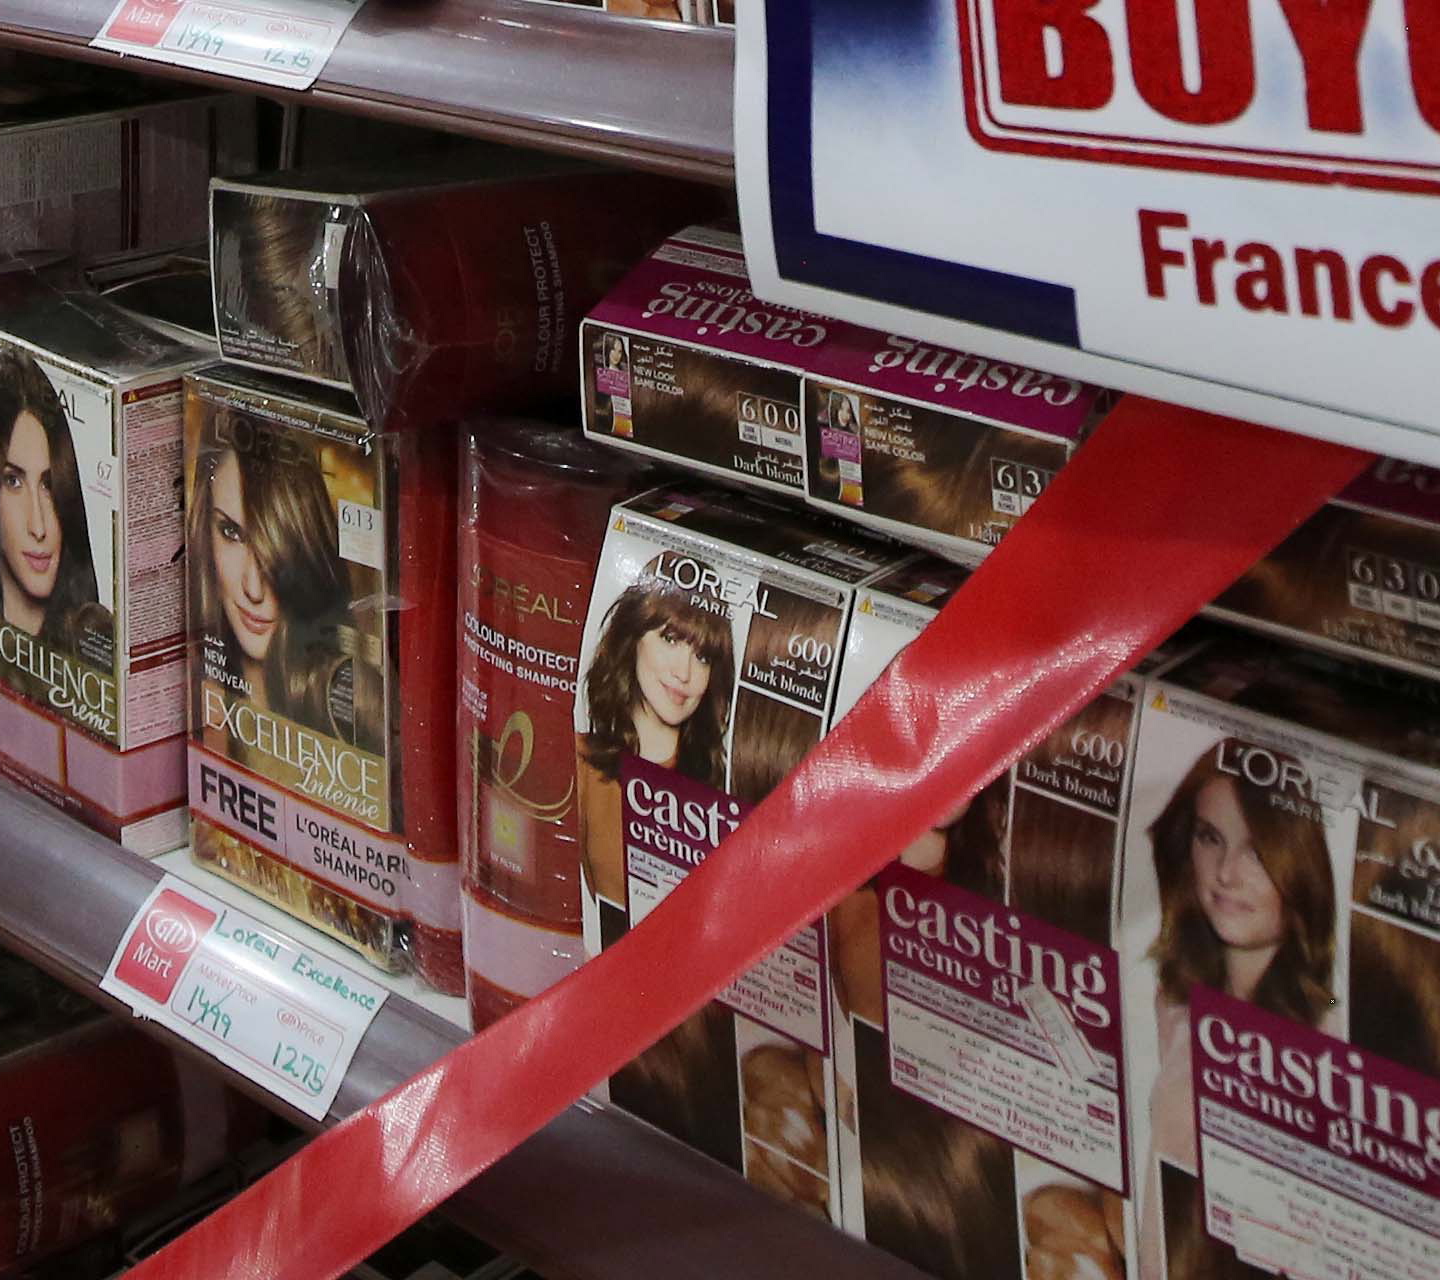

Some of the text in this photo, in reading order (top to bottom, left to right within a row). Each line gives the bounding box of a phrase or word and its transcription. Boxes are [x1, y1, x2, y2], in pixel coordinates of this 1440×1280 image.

[126, 5, 166, 26] Mart
[642, 282, 827, 348] casting
[633, 365, 676, 383] NEW LOOK
[633, 377, 684, 396] SAME COLOR
[733, 455, 764, 475] Dark
[892, 447, 926, 463] COLOR
[341, 502, 375, 531] 6.13
[654, 553, 778, 620] L'ORÉAL
[689, 593, 735, 620] PARIS
[203, 647, 227, 668] NEW
[507, 637, 578, 674] PROTECT
[787, 633, 832, 668] 600
[203, 662, 253, 696] NOUVEAU
[747, 661, 823, 704] Dark blonde
[204, 687, 380, 801] EXCELLENCE
[1071, 728, 1125, 769] 600
[200, 763, 278, 842] FREE
[295, 761, 380, 821] Intense
[1024, 759, 1117, 809] Dark blonde
[295, 812, 362, 859] L'ORÉAL
[628, 819, 706, 866] crème
[312, 846, 396, 898] SHAMPOO
[132, 942, 174, 978] Mart
[884, 884, 1112, 1030] casting
[888, 934, 981, 989] crème
[272, 1042, 325, 1092] 1275
[1204, 1063, 1318, 1134] crème
